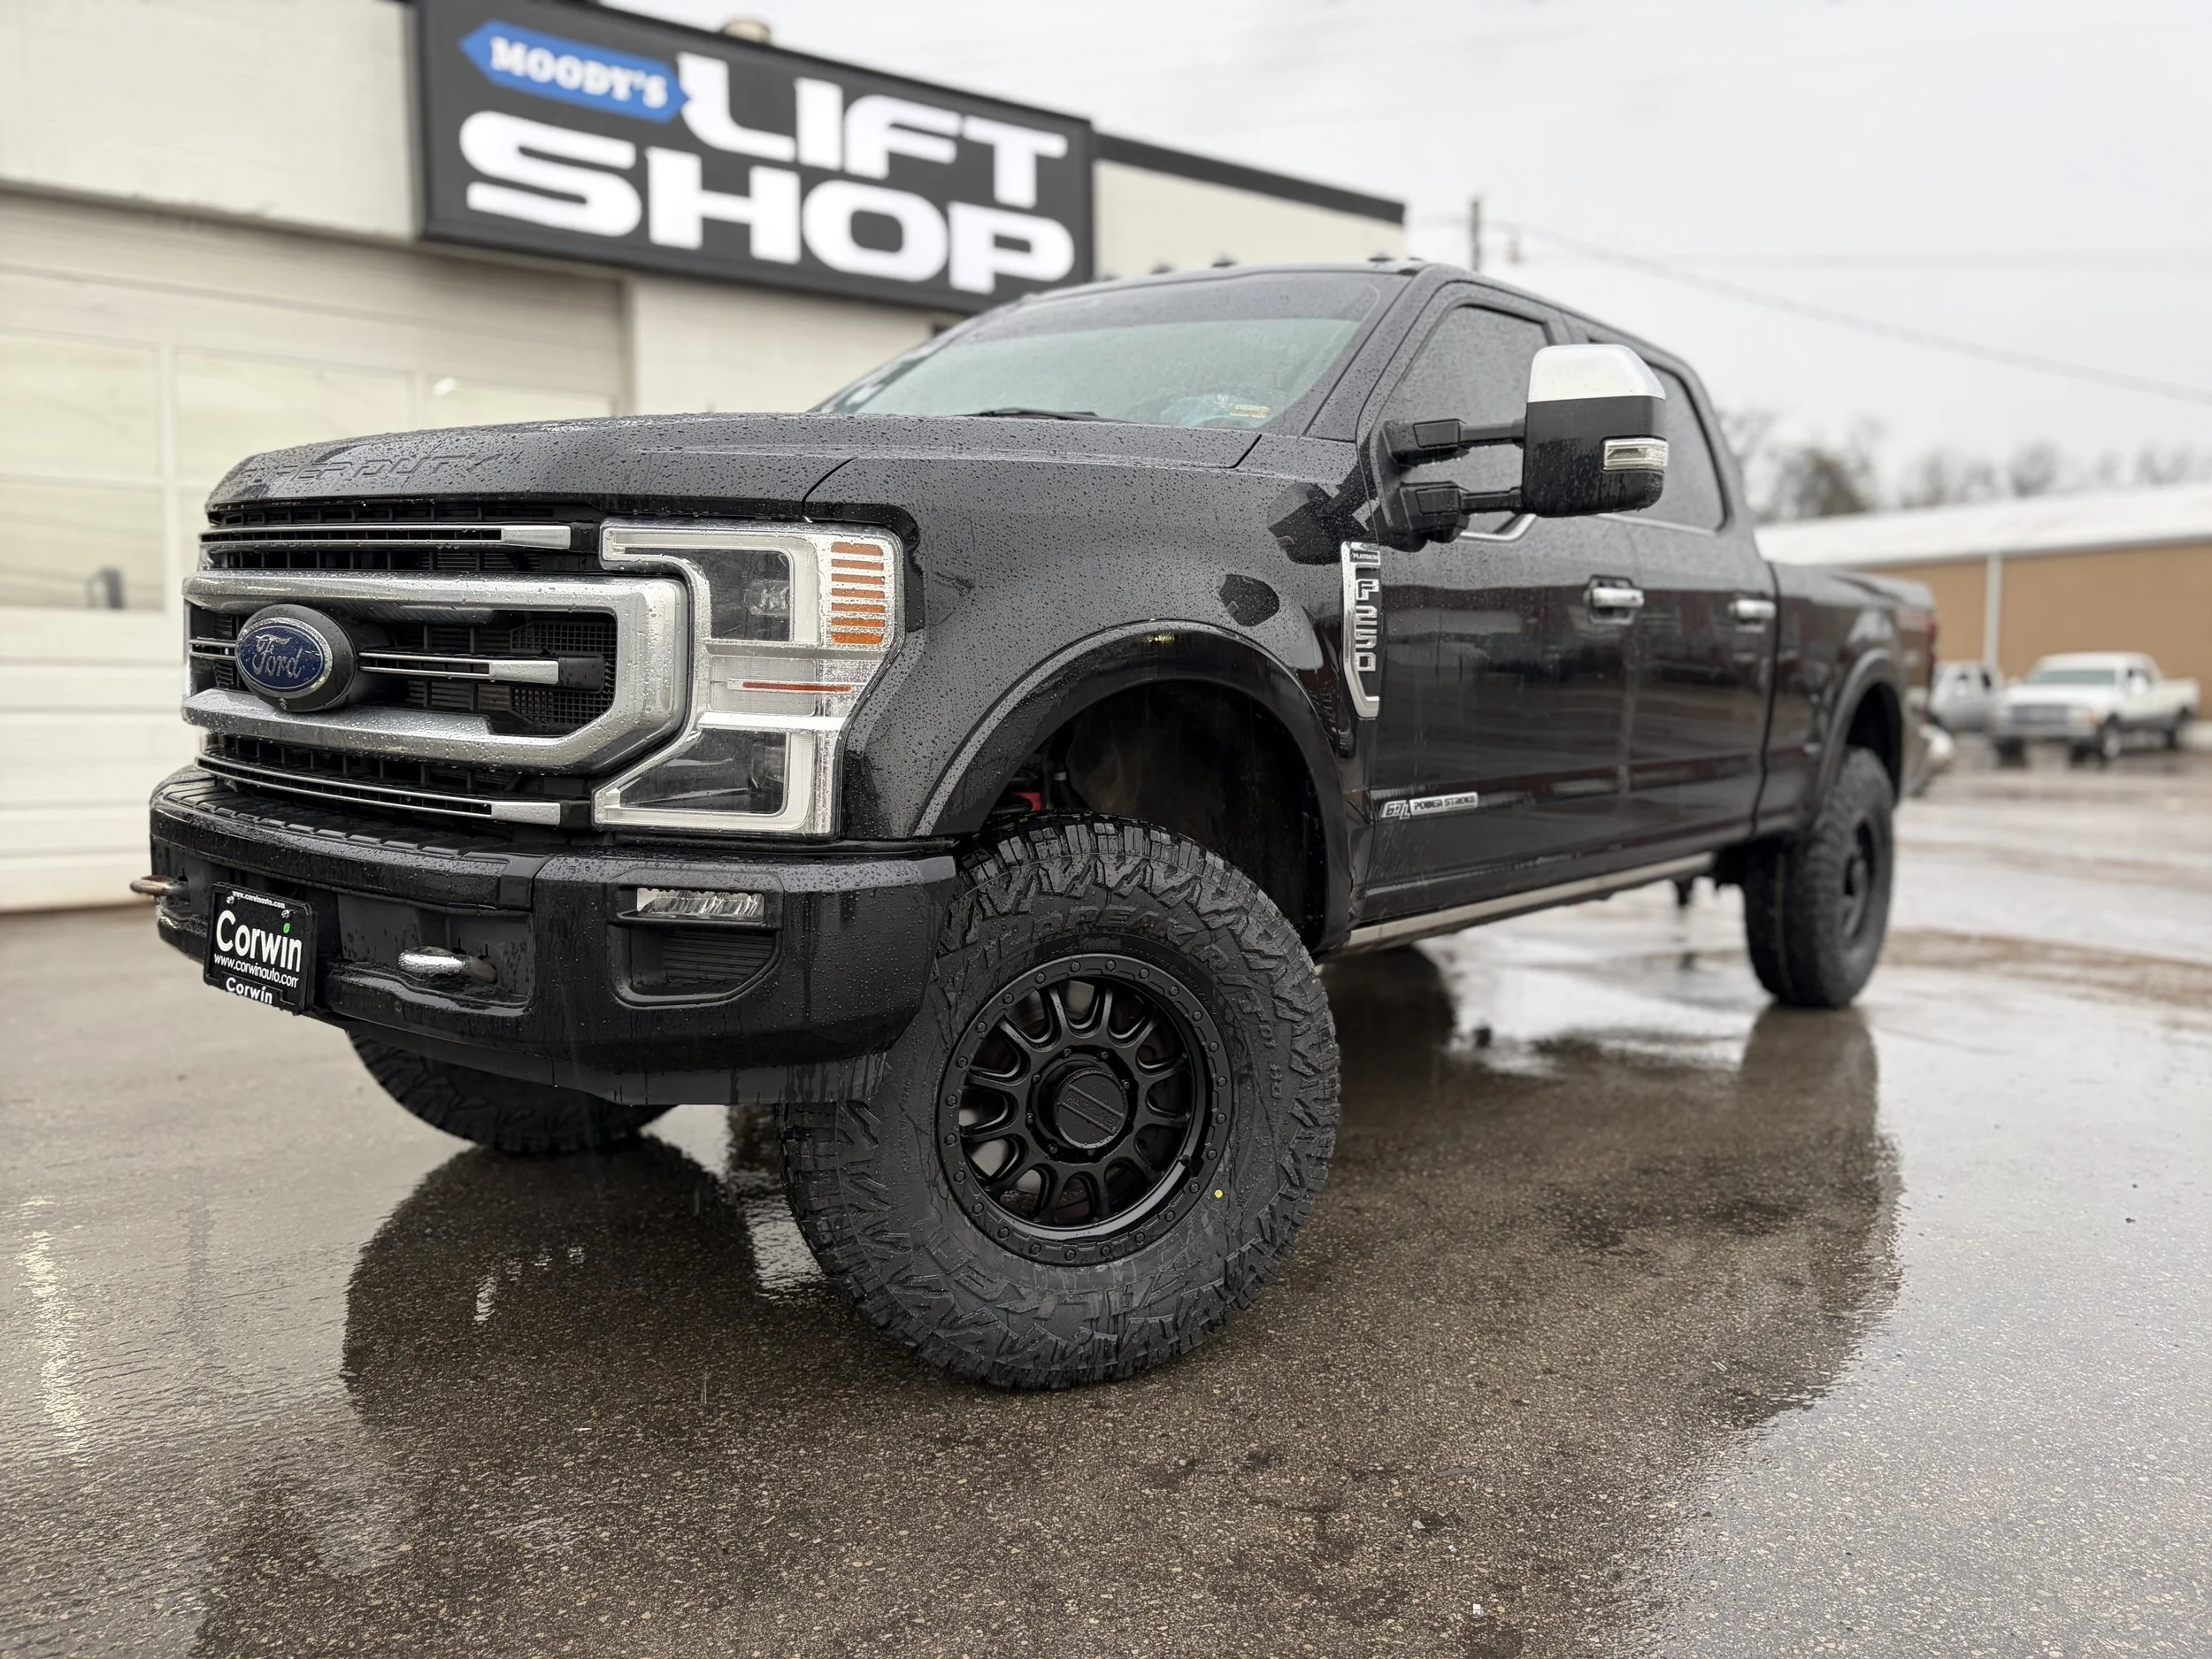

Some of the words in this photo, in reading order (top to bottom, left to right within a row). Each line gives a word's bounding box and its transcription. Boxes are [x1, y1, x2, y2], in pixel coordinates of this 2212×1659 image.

[489, 35, 668, 109] MOODY'S
[675, 50, 1068, 209] LIFT
[458, 110, 1075, 294] SHOP
[354, 451, 504, 479] DUTY
[251, 634, 303, 679] Ford
[1413, 799, 1444, 810] POWER
[1444, 795, 1476, 807] STROKE
[216, 910, 303, 973] Corwin
[226, 977, 273, 1004] Corwin
